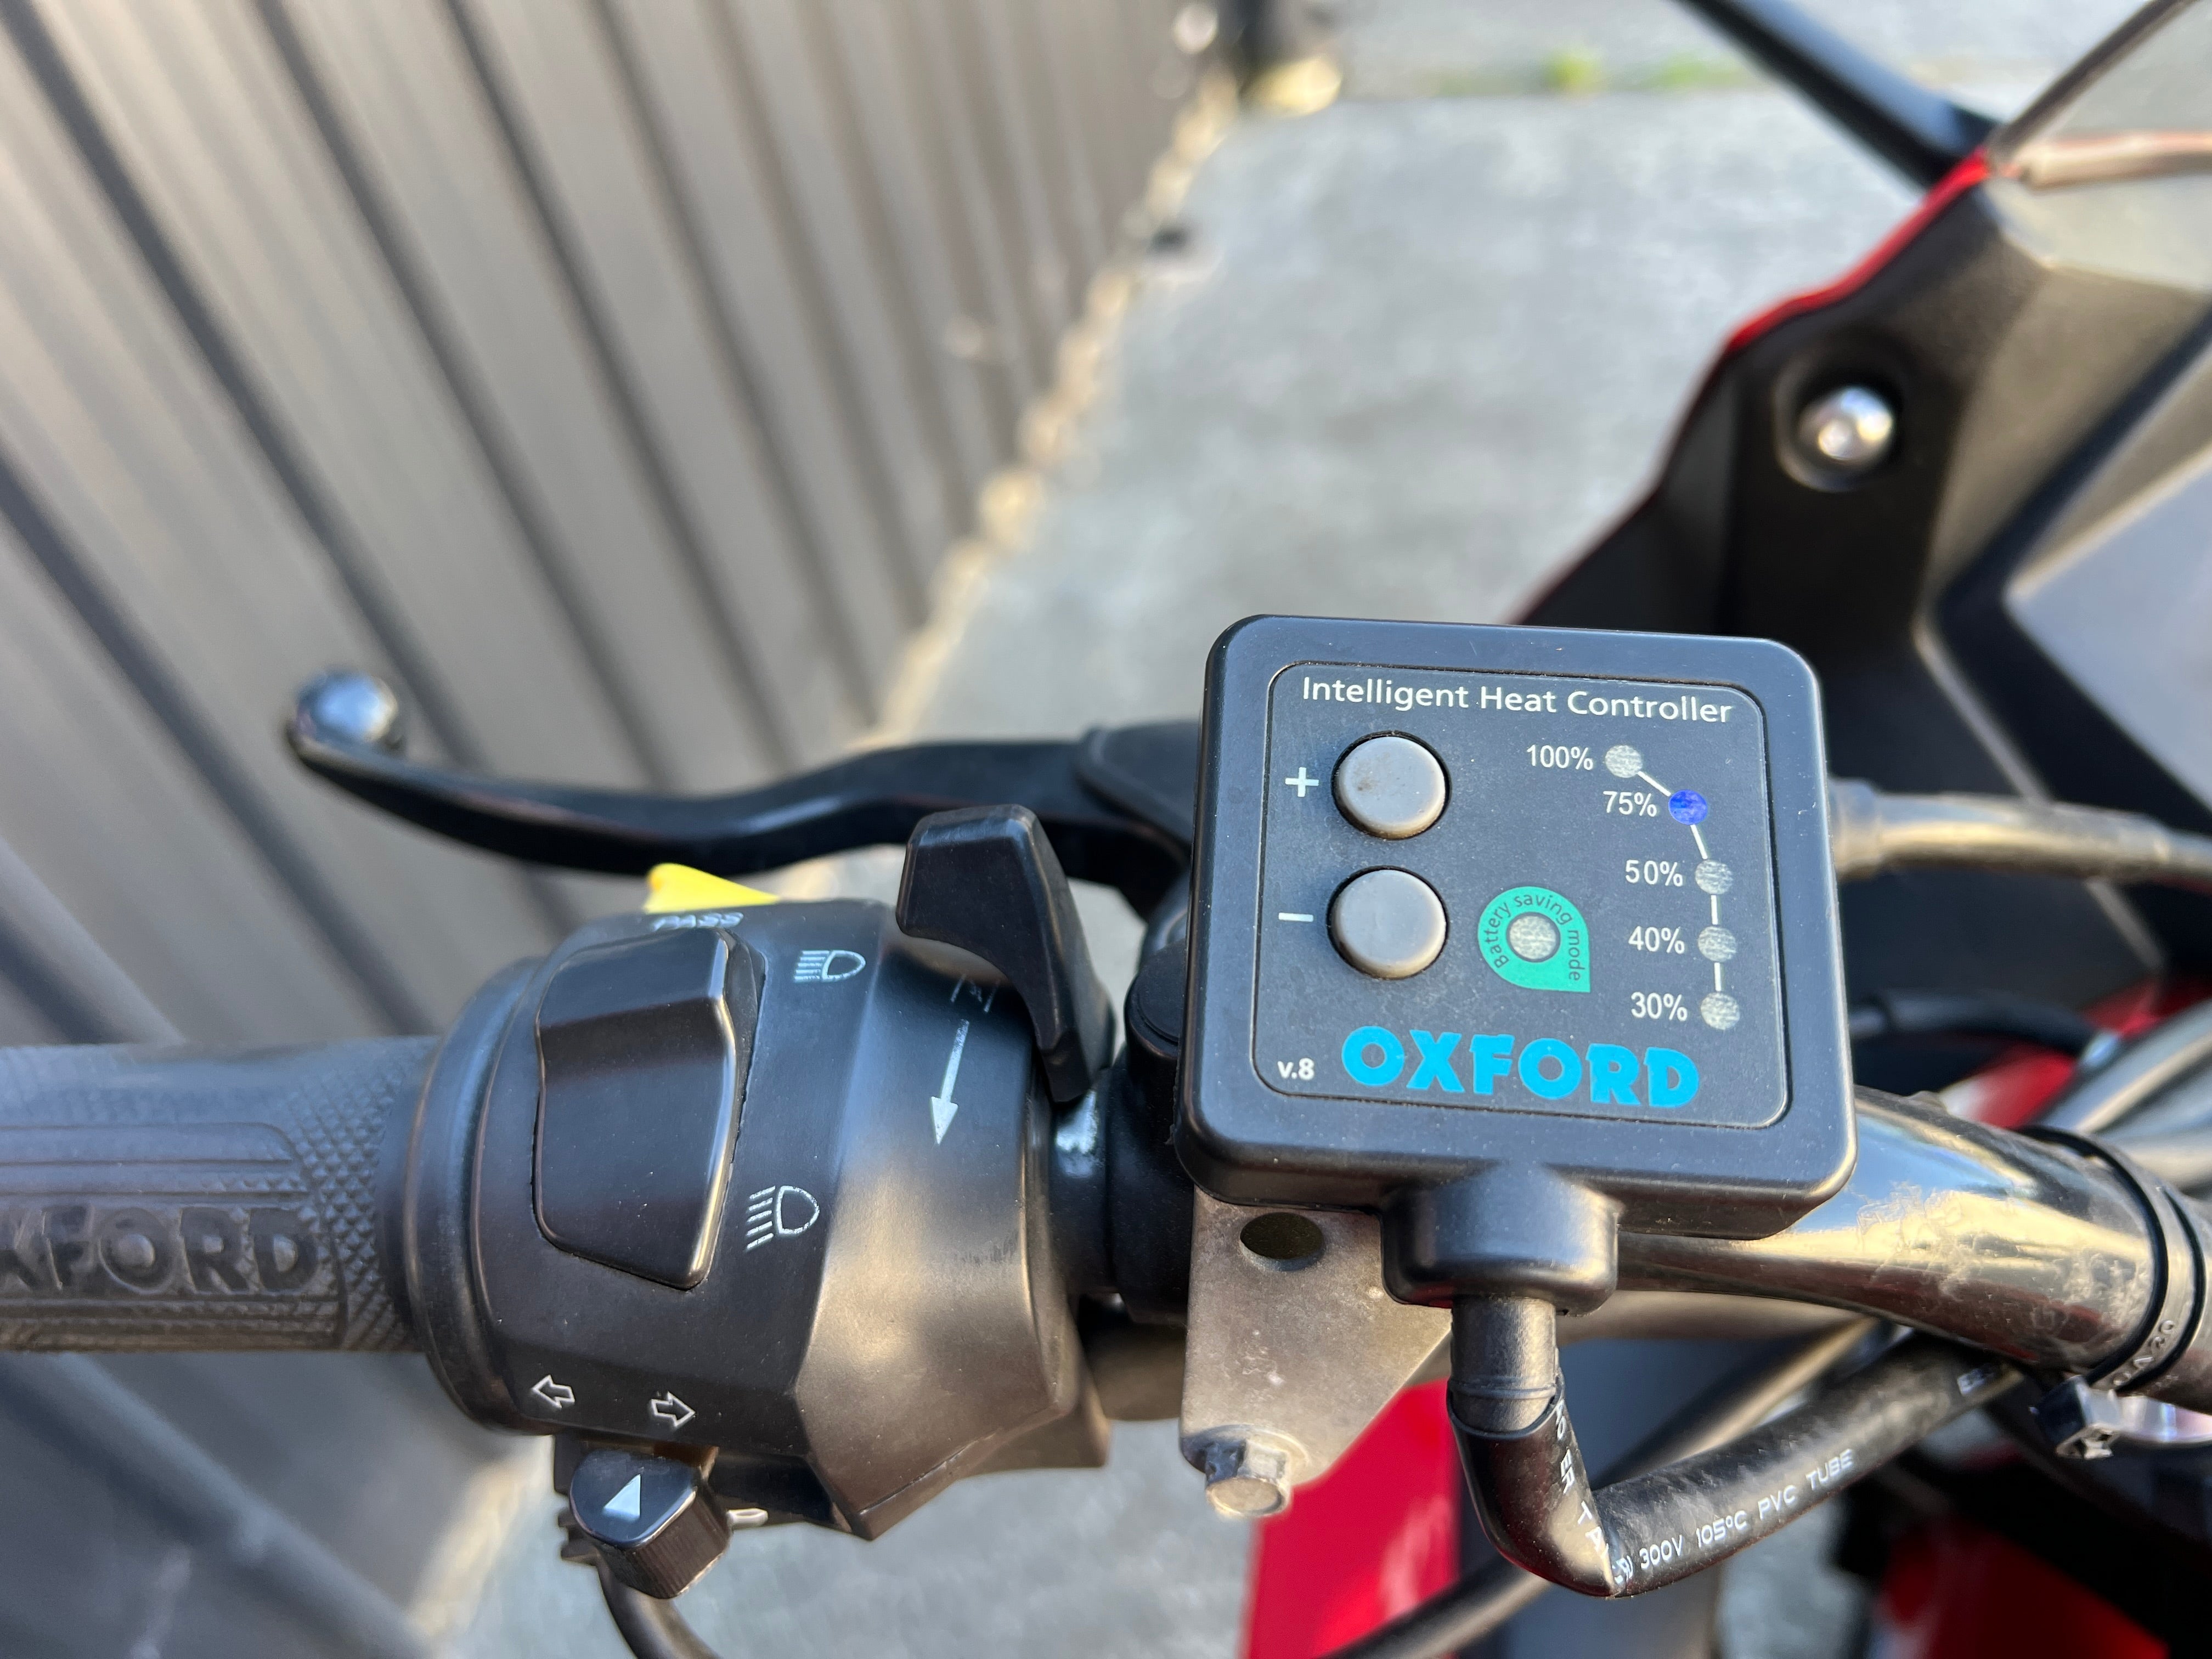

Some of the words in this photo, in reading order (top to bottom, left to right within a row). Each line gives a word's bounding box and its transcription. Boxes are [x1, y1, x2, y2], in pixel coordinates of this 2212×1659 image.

[1303, 676, 1469, 710] Intelligent
[1481, 686, 1557, 713] Heat
[1567, 691, 1733, 723] Controller
[1527, 744, 1594, 771] 100%
[1603, 791, 1657, 817] 75%
[1624, 860, 1683, 887] 50%
[1483, 902, 1511, 969] Battery
[1514, 894, 1573, 926] saving
[1567, 930, 1585, 981] mode
[1628, 926, 1685, 954] 40%
[1631, 992, 1688, 1022] 30%
[1277, 1058, 1315, 1081] v.8
[1341, 1025, 1699, 1108] OXFORD
[1639, 1534, 1683, 1570] 300V
[1758, 1485, 1797, 1520] PVC
[1805, 1448, 1854, 1491] TUBE
